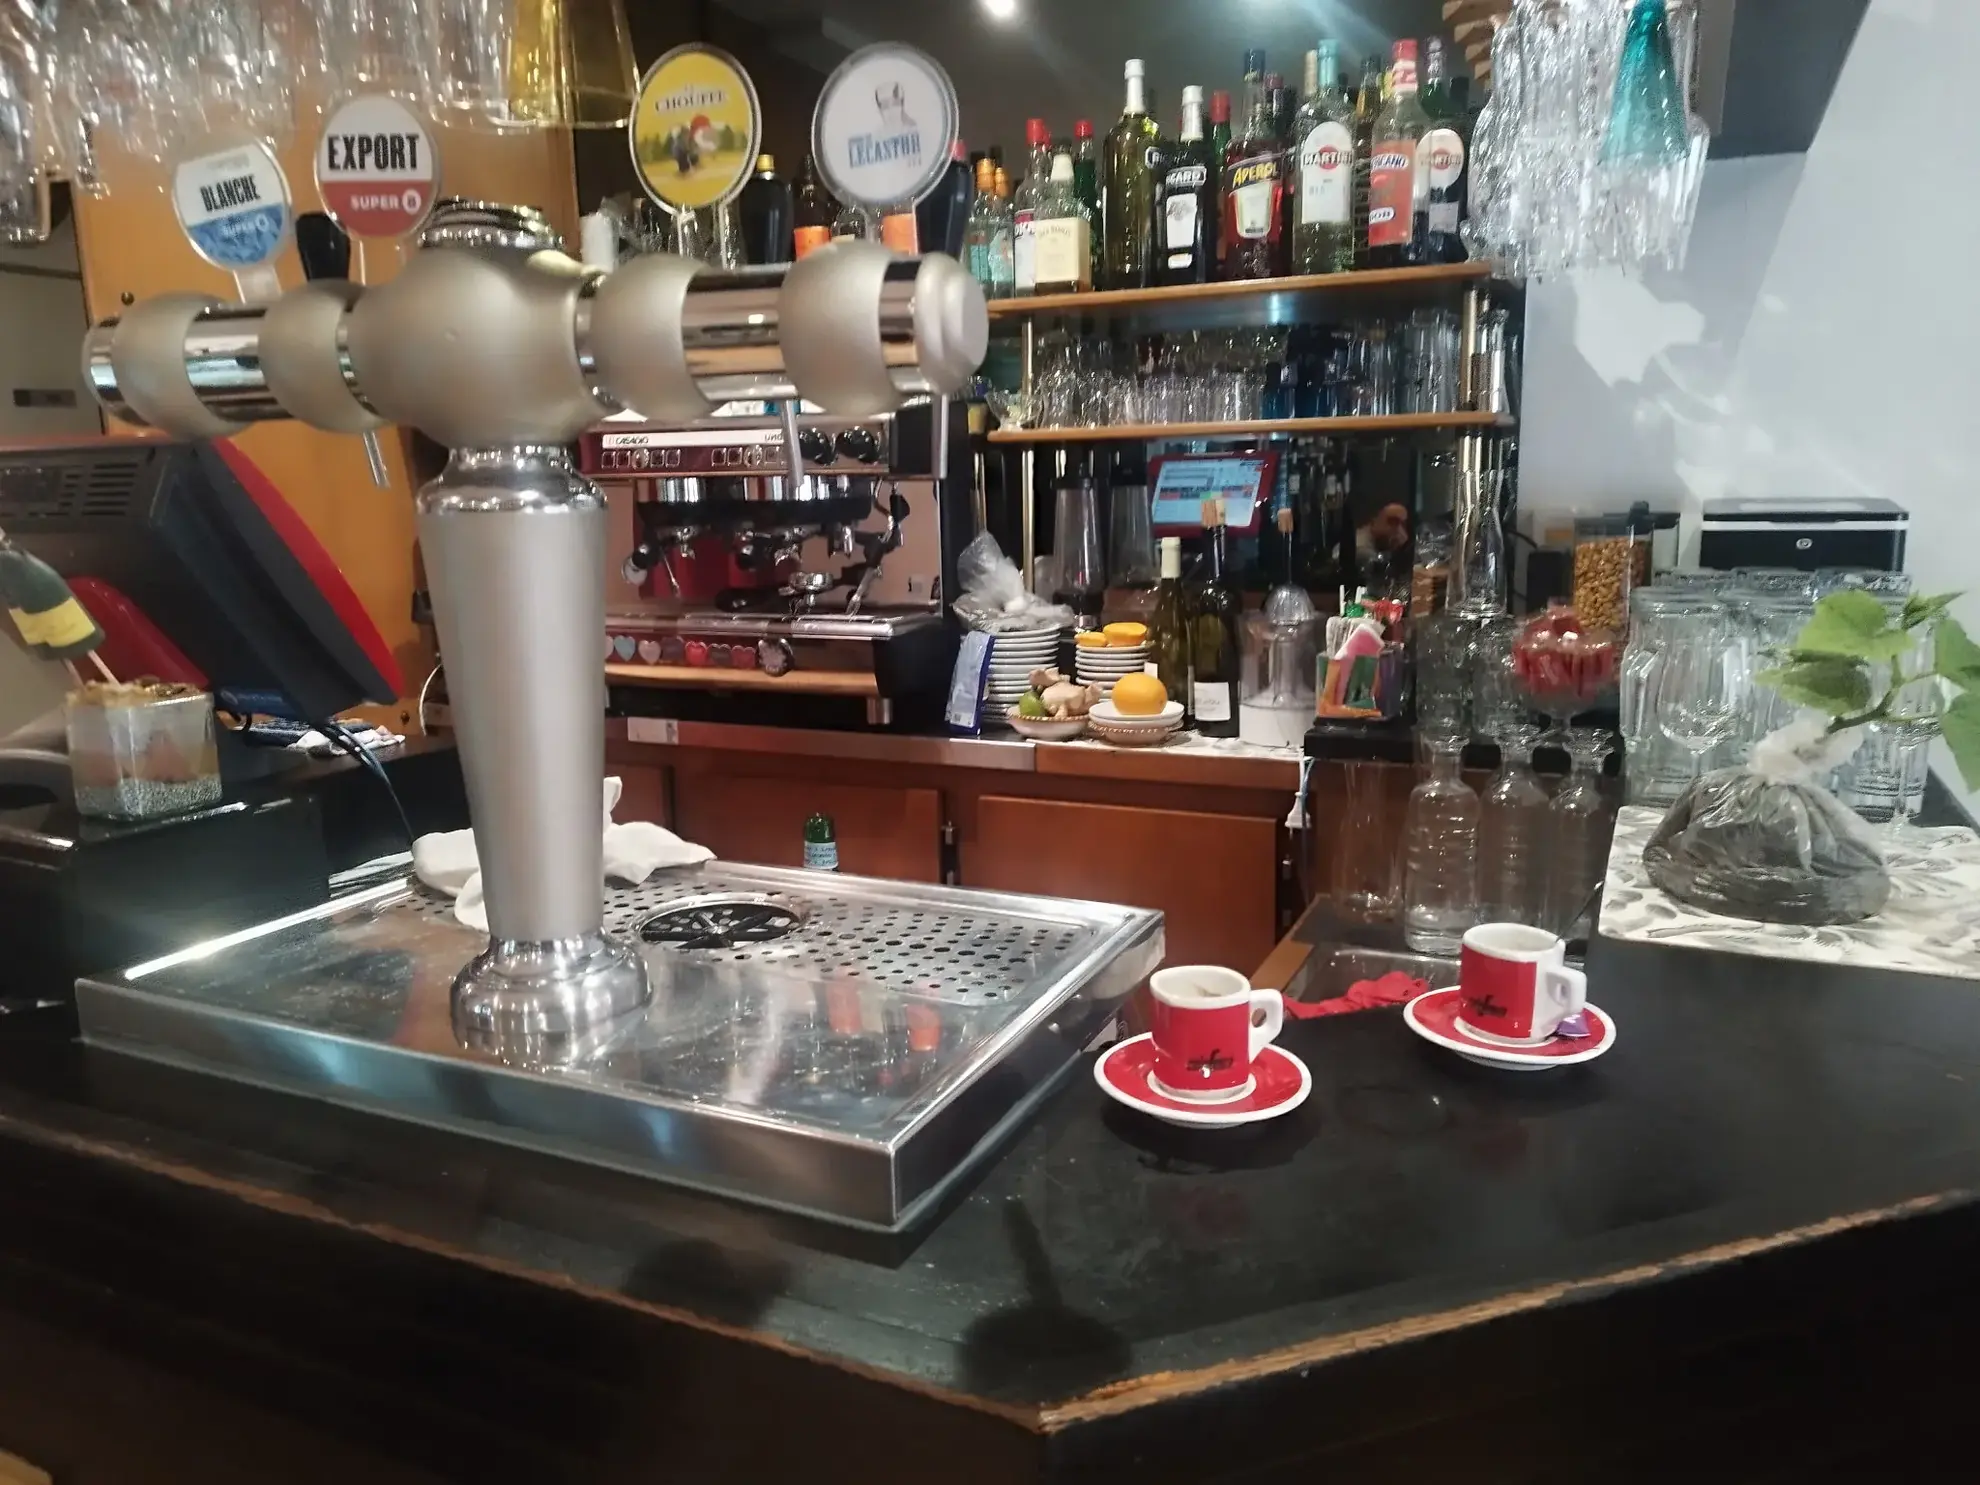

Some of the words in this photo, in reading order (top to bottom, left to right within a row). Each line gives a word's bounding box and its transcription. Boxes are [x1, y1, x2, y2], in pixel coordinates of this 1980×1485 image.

[328, 134, 419, 170] EXPORT
[1232, 162, 1278, 189] APEROL
[200, 174, 261, 212] BLANCHE
[351, 194, 399, 211] SUPER
